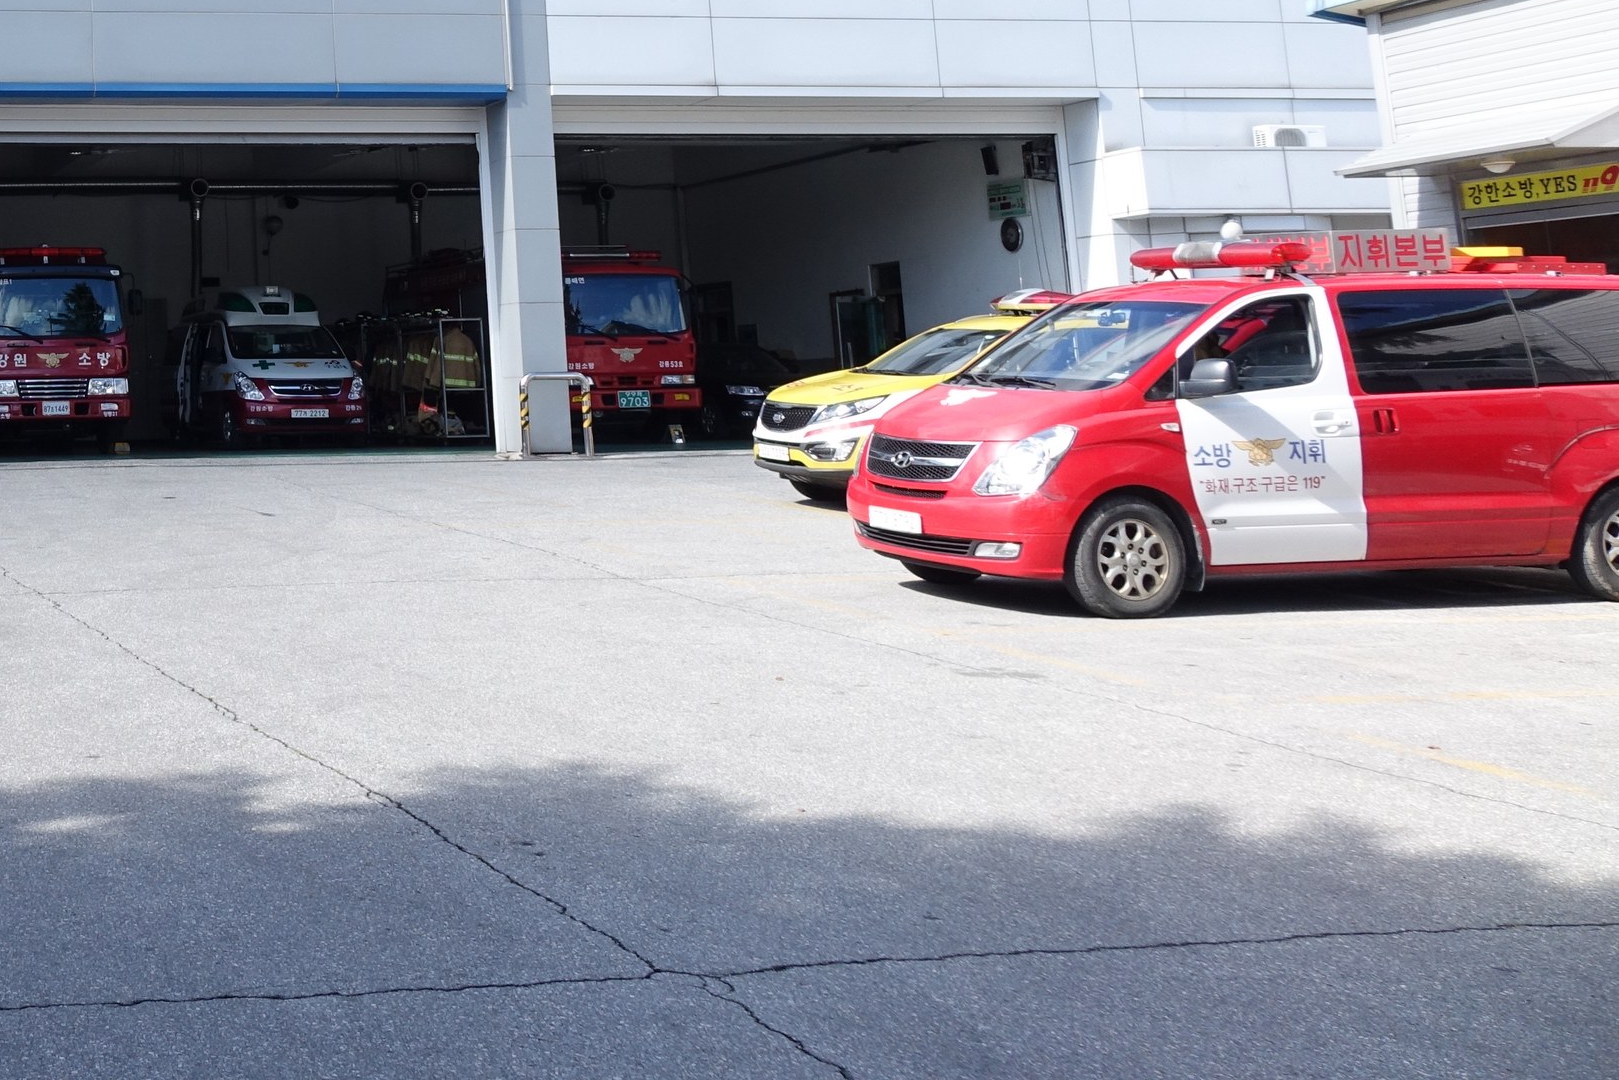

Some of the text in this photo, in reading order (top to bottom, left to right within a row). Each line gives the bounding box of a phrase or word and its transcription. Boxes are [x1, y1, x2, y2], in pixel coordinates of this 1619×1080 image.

[1468, 175, 1577, 205] 강한소방,YES
[1337, 233, 1446, 268] 지휘본부
[78, 352, 111, 367] 소방
[621, 397, 649, 408] 9703
[1193, 439, 1327, 469] 소방 지휘
